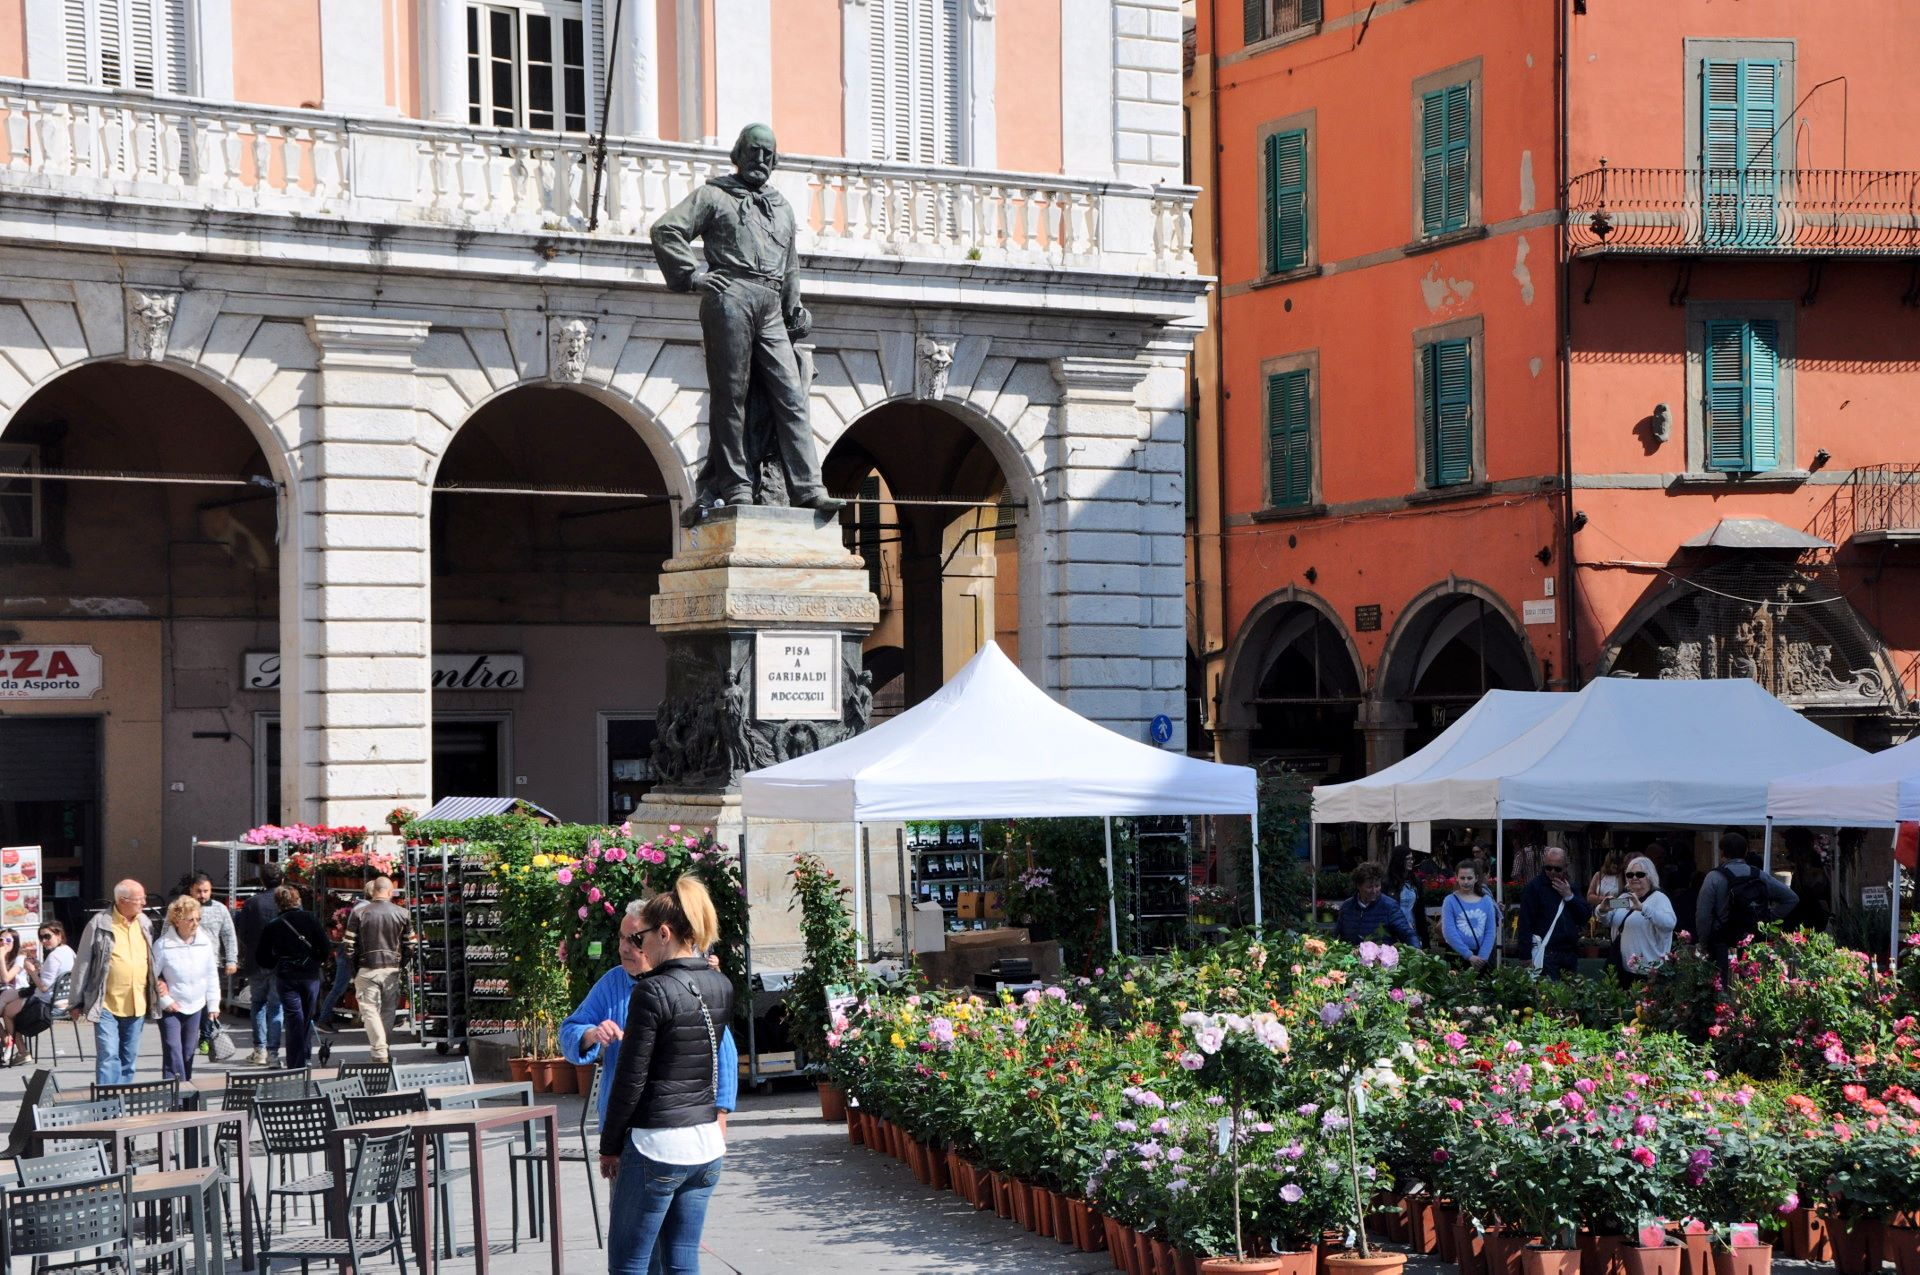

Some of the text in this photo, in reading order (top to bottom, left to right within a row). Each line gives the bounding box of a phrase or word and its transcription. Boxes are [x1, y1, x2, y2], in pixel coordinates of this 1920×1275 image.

[784, 646, 811, 656] PISA
[0, 649, 79, 679] ZA
[794, 658, 801, 668] A
[432, 655, 520, 688] ntro
[768, 672, 827, 682] GARIBALDI
[1, 679, 80, 691] da Asporto
[771, 691, 825, 702] MDCCCXCII
